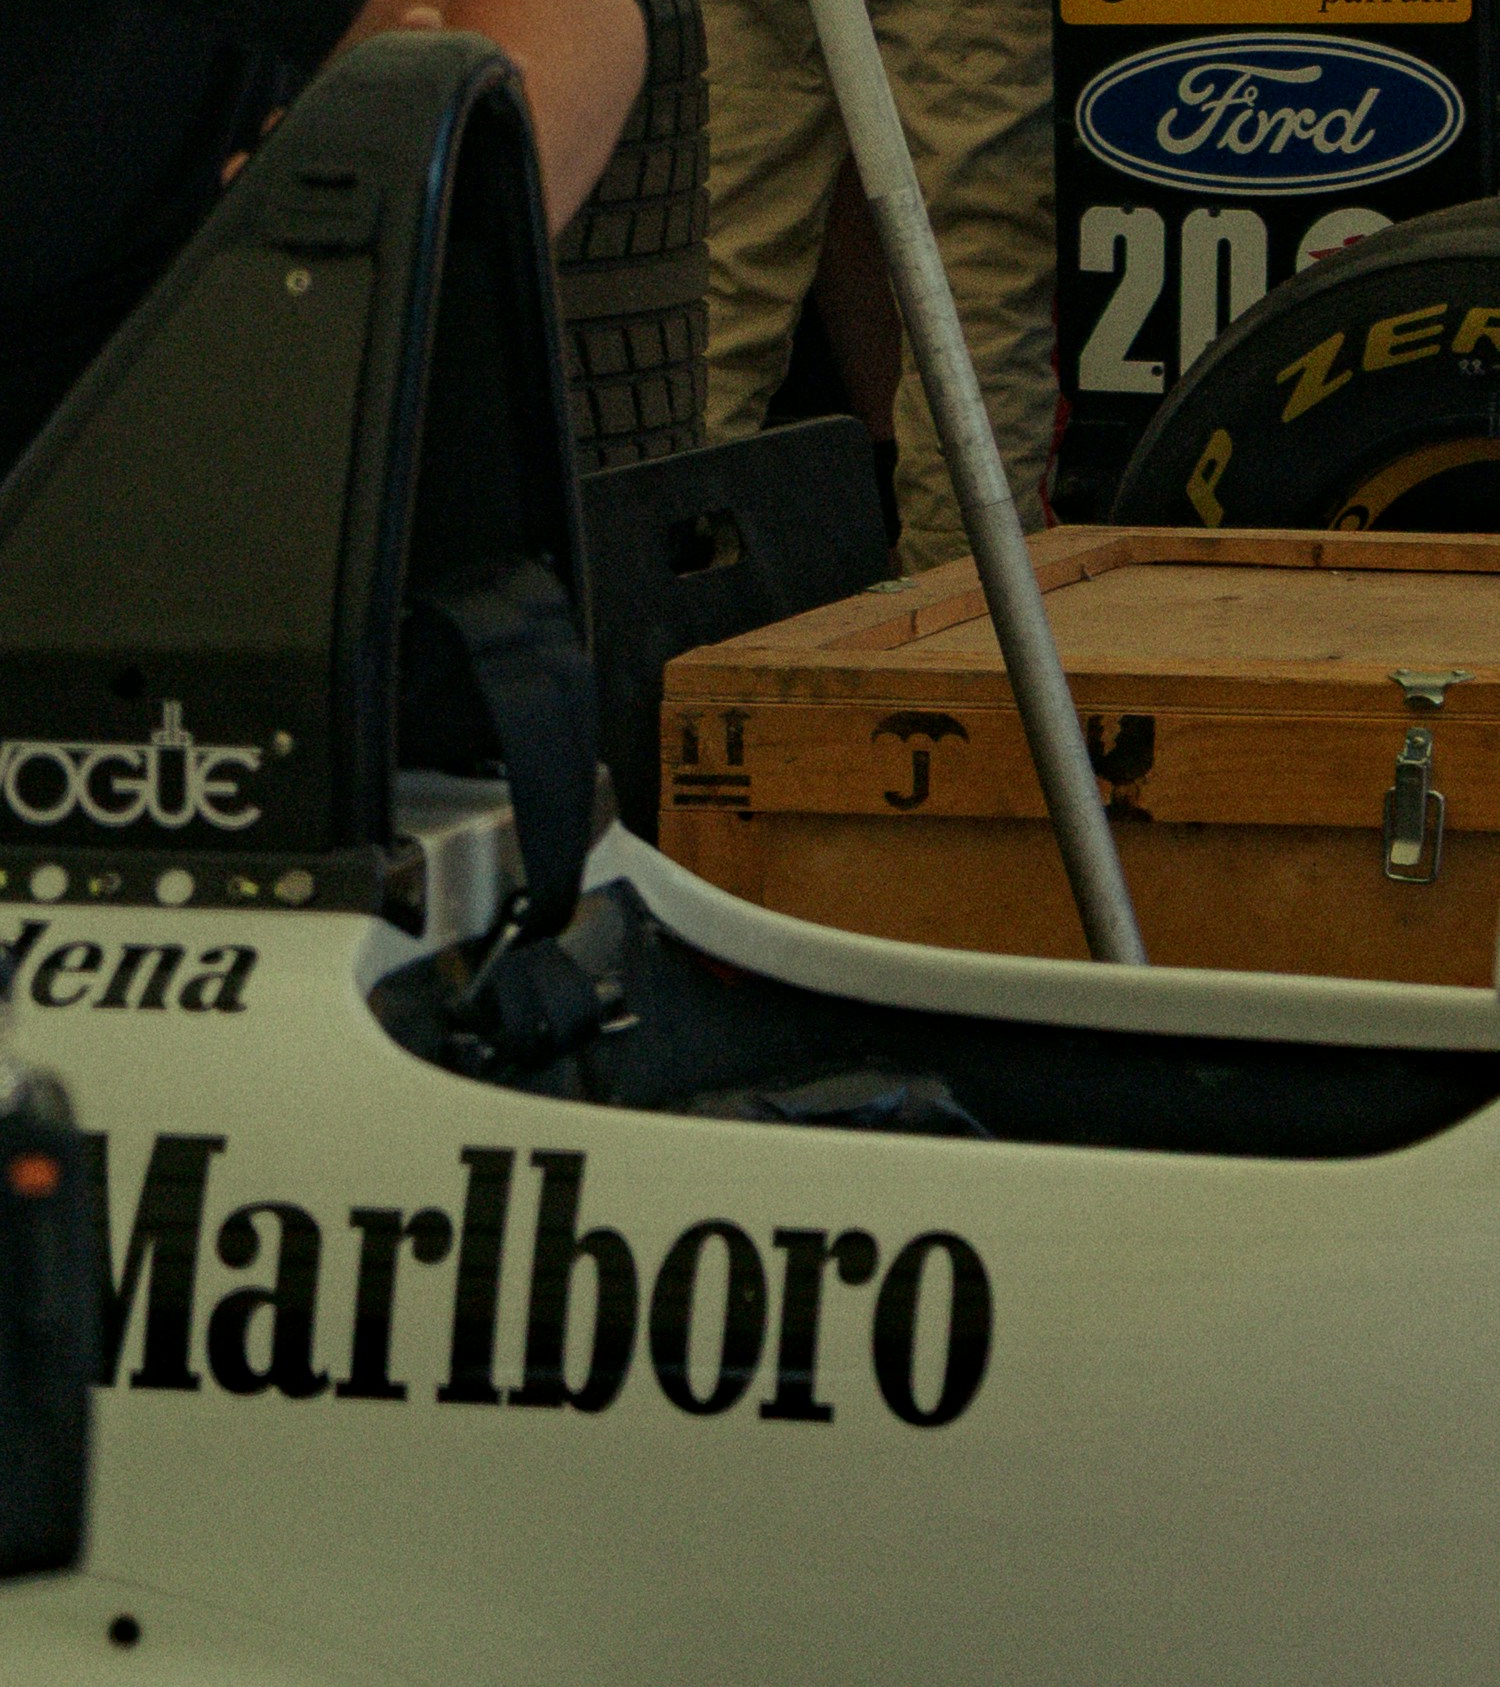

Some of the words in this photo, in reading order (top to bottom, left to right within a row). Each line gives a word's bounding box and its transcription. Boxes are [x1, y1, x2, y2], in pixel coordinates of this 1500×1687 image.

[1156, 62, 1381, 155] Ford
[1079, 206, 1395, 394] 20
[1, 743, 262, 830] OGUE
[84, 1131, 995, 1428] Marlboro
